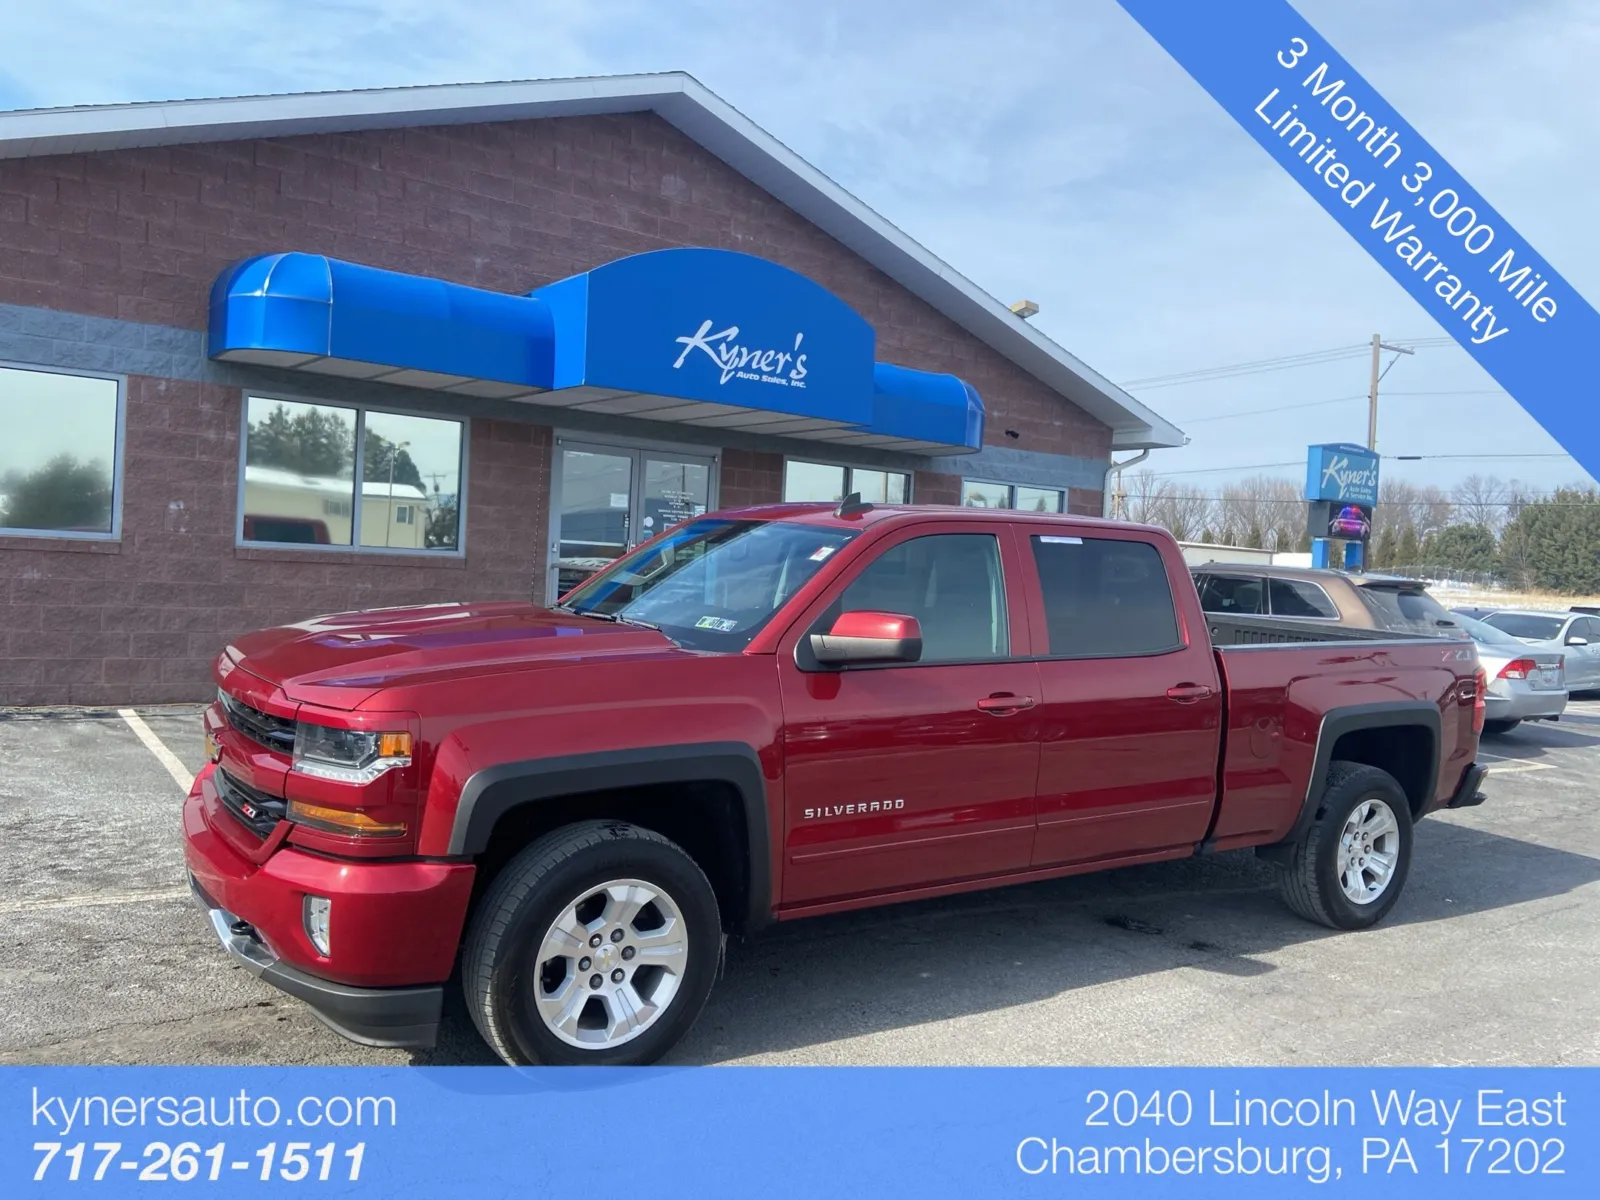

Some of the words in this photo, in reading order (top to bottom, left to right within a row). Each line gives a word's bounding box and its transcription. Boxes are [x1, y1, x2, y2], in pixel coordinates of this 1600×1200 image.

[673, 319, 807, 385] Kyner's
[736, 371, 760, 381] Auto
[761, 375, 789, 387] Sales,
[791, 380, 807, 389] Inc.
[1321, 455, 1376, 499] Kyner's
[1360, 486, 1372, 494] Sales
[803, 799, 905, 819] SILVERADO
